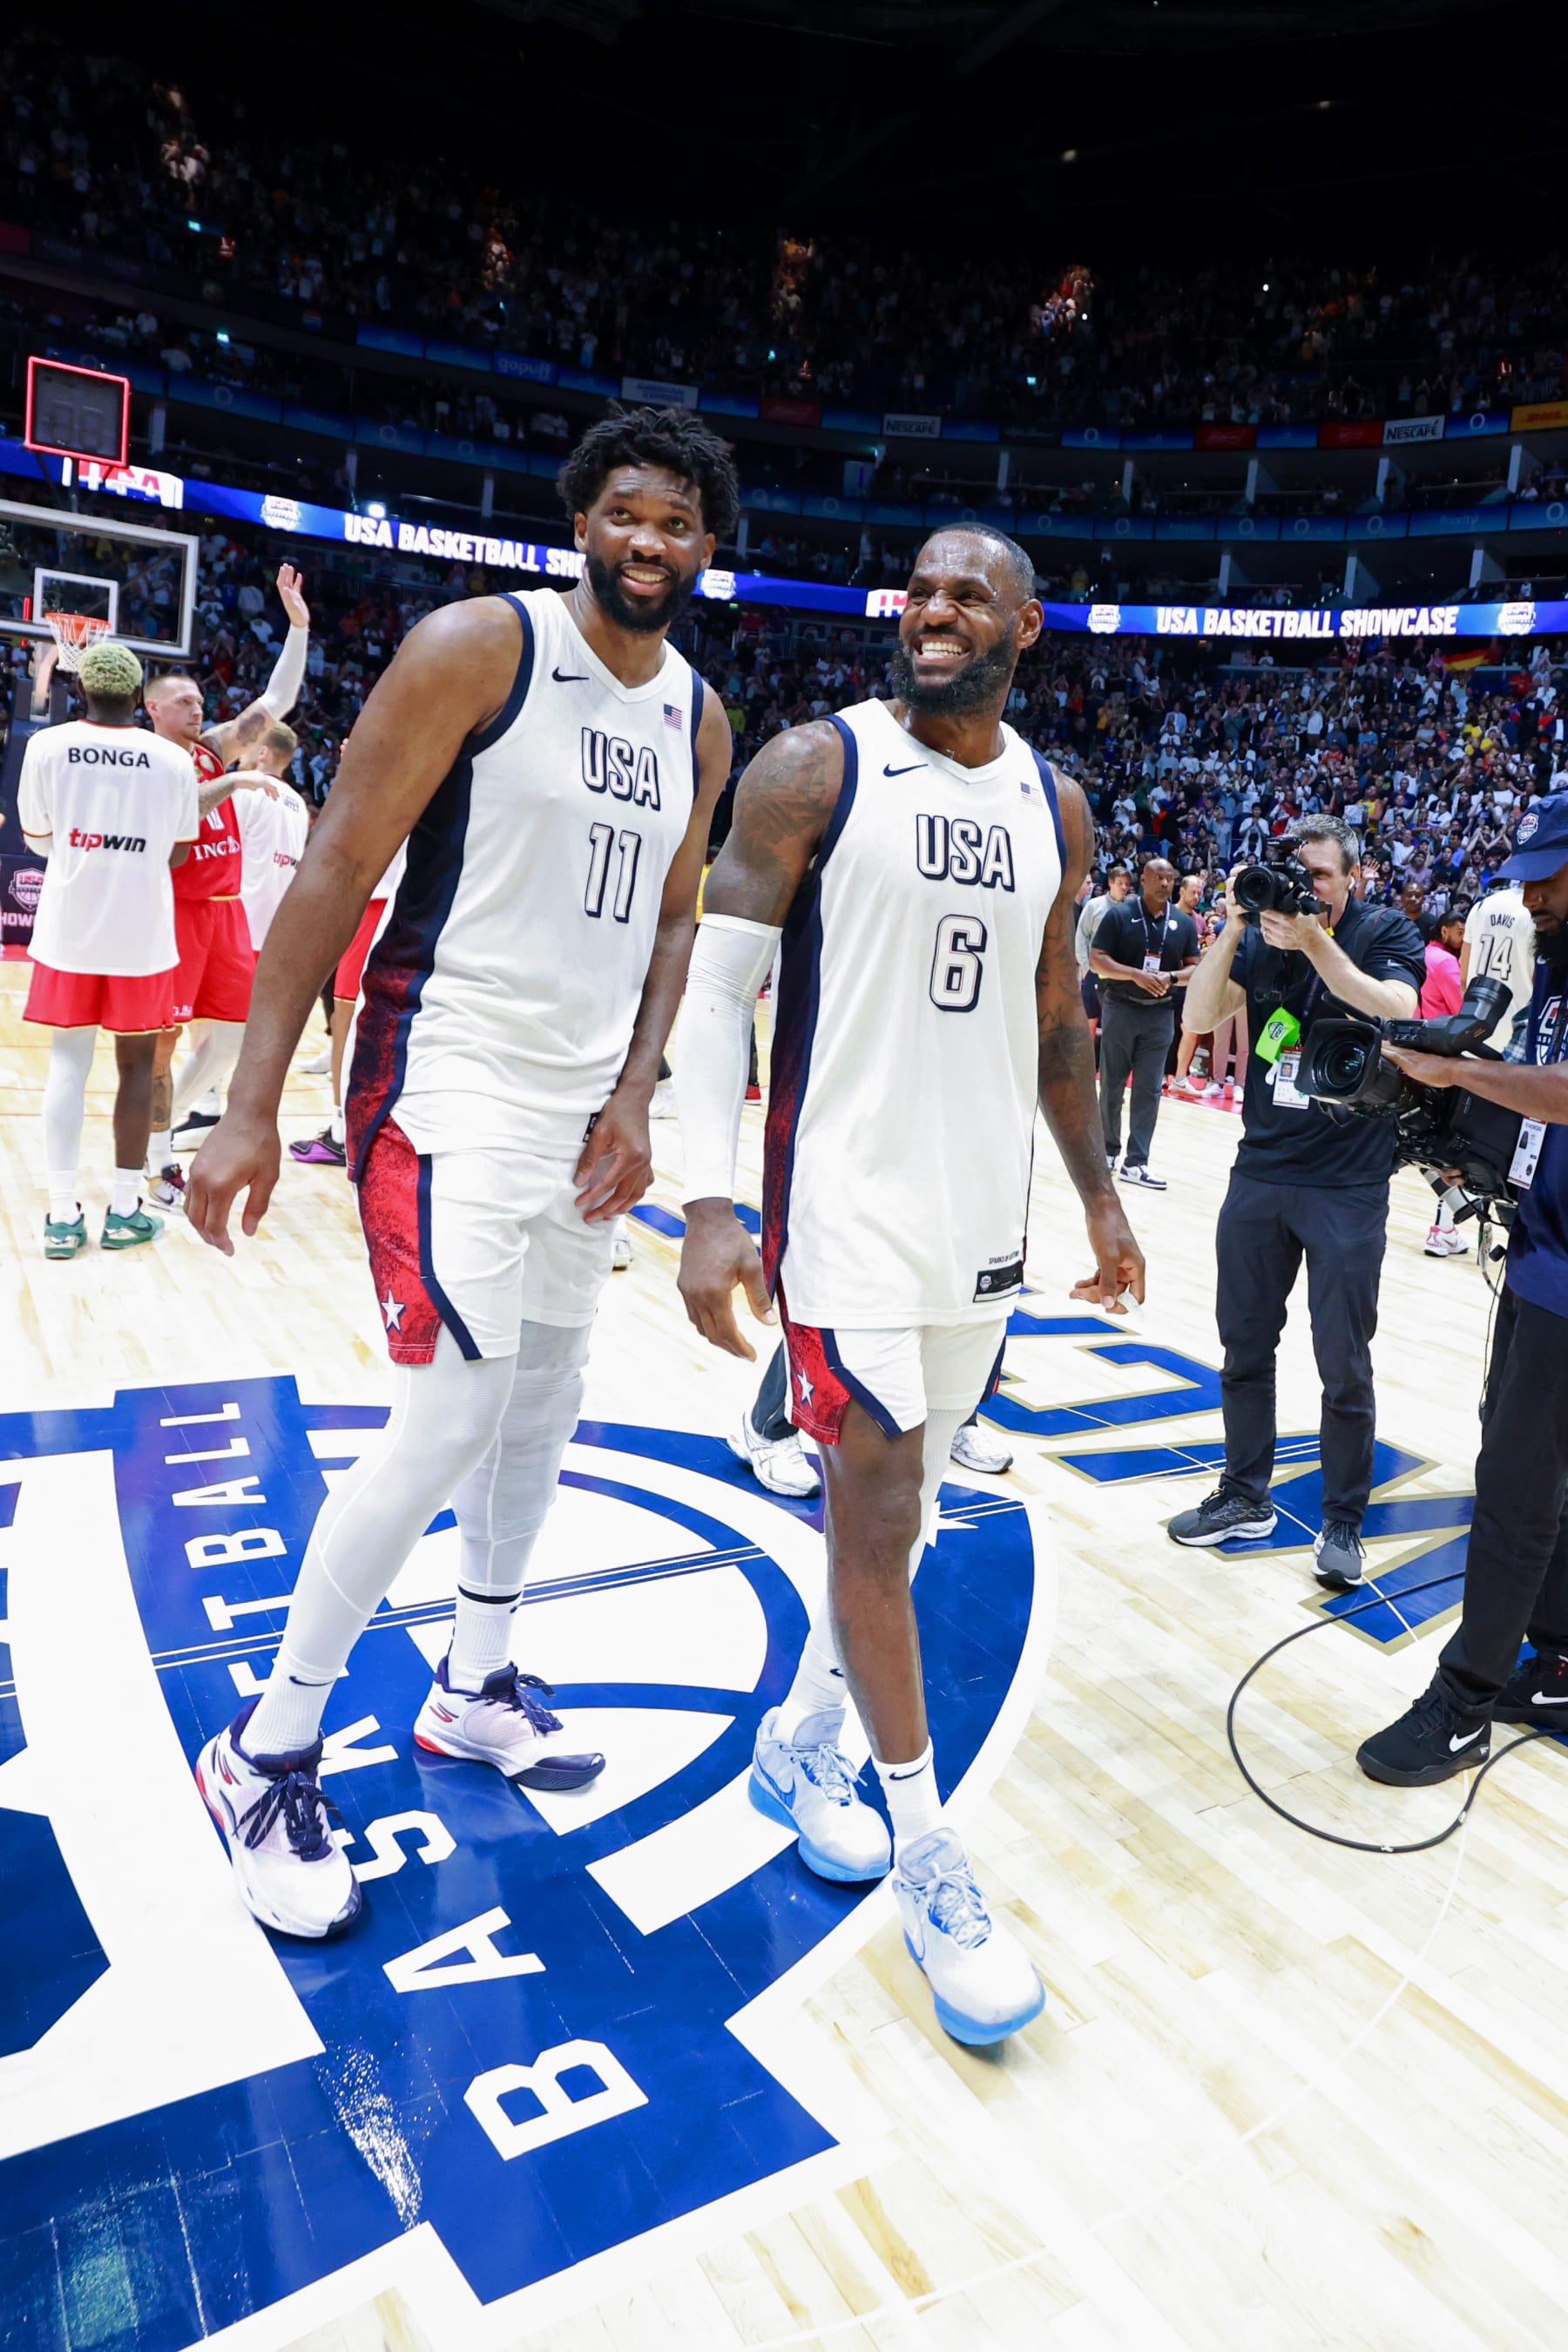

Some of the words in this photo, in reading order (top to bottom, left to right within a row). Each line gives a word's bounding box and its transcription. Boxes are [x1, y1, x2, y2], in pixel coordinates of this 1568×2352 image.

[344, 512, 394, 549] USA
[398, 523, 540, 573] BASKETBALL
[1156, 607, 1198, 634] USA
[1203, 609, 1335, 638] BASKETBALL
[1340, 606, 1459, 637] SHOWCASE
[68, 747, 151, 769] BONGA
[581, 727, 661, 811] USA
[69, 827, 147, 853] tipwin
[193, 840, 227, 861] ING
[916, 814, 1016, 893] USA
[584, 821, 641, 923] 11
[0, 911, 33, 928] HOW
[1490, 913, 1516, 929] DAVIS
[929, 914, 987, 1012] 6
[1476, 933, 1513, 981] 14
